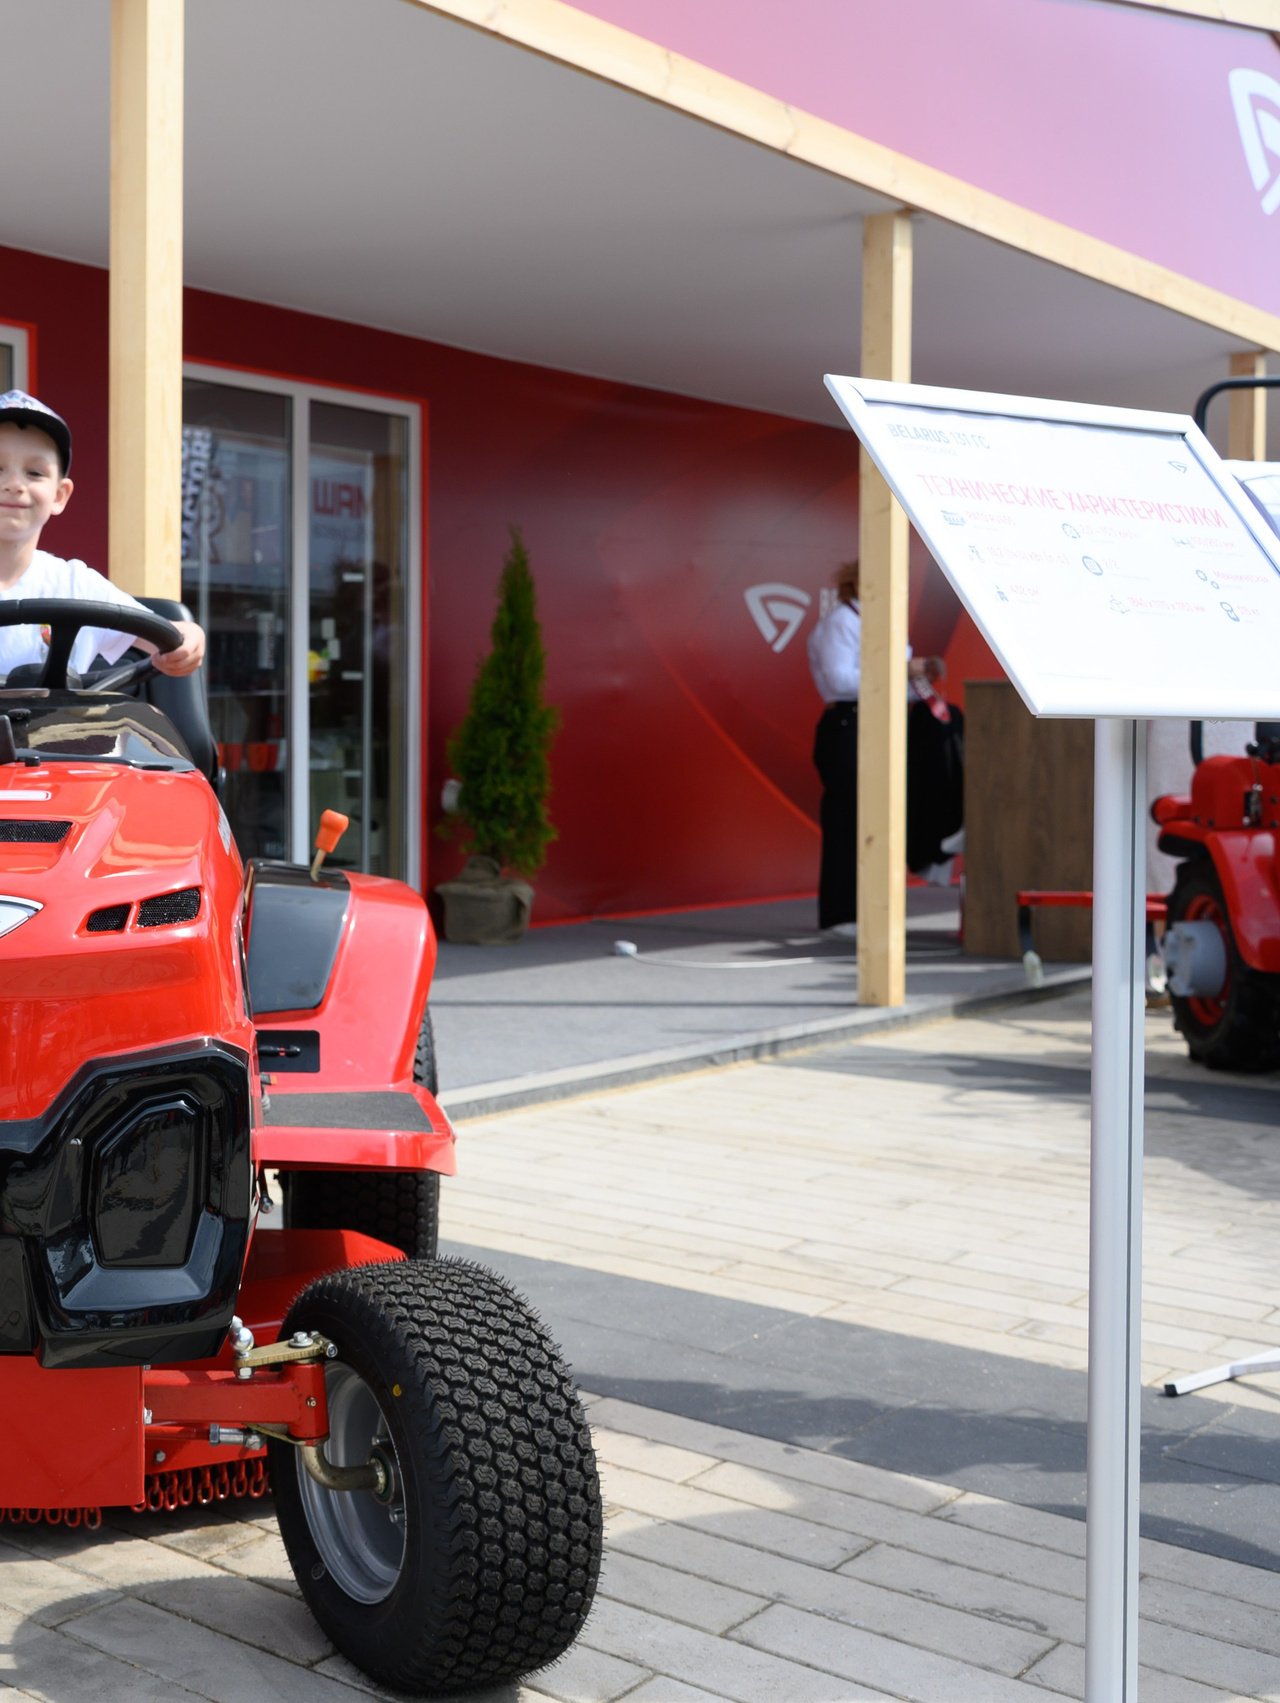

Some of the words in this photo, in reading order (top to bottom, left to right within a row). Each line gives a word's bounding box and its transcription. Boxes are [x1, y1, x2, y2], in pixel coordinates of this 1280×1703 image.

[886, 423, 951, 444] BELARUS
[916, 474, 1066, 510] ТЕХНИЧЕСКИЕ
[1061, 491, 1228, 528] ХАРАКТЕРИСТИКИ
